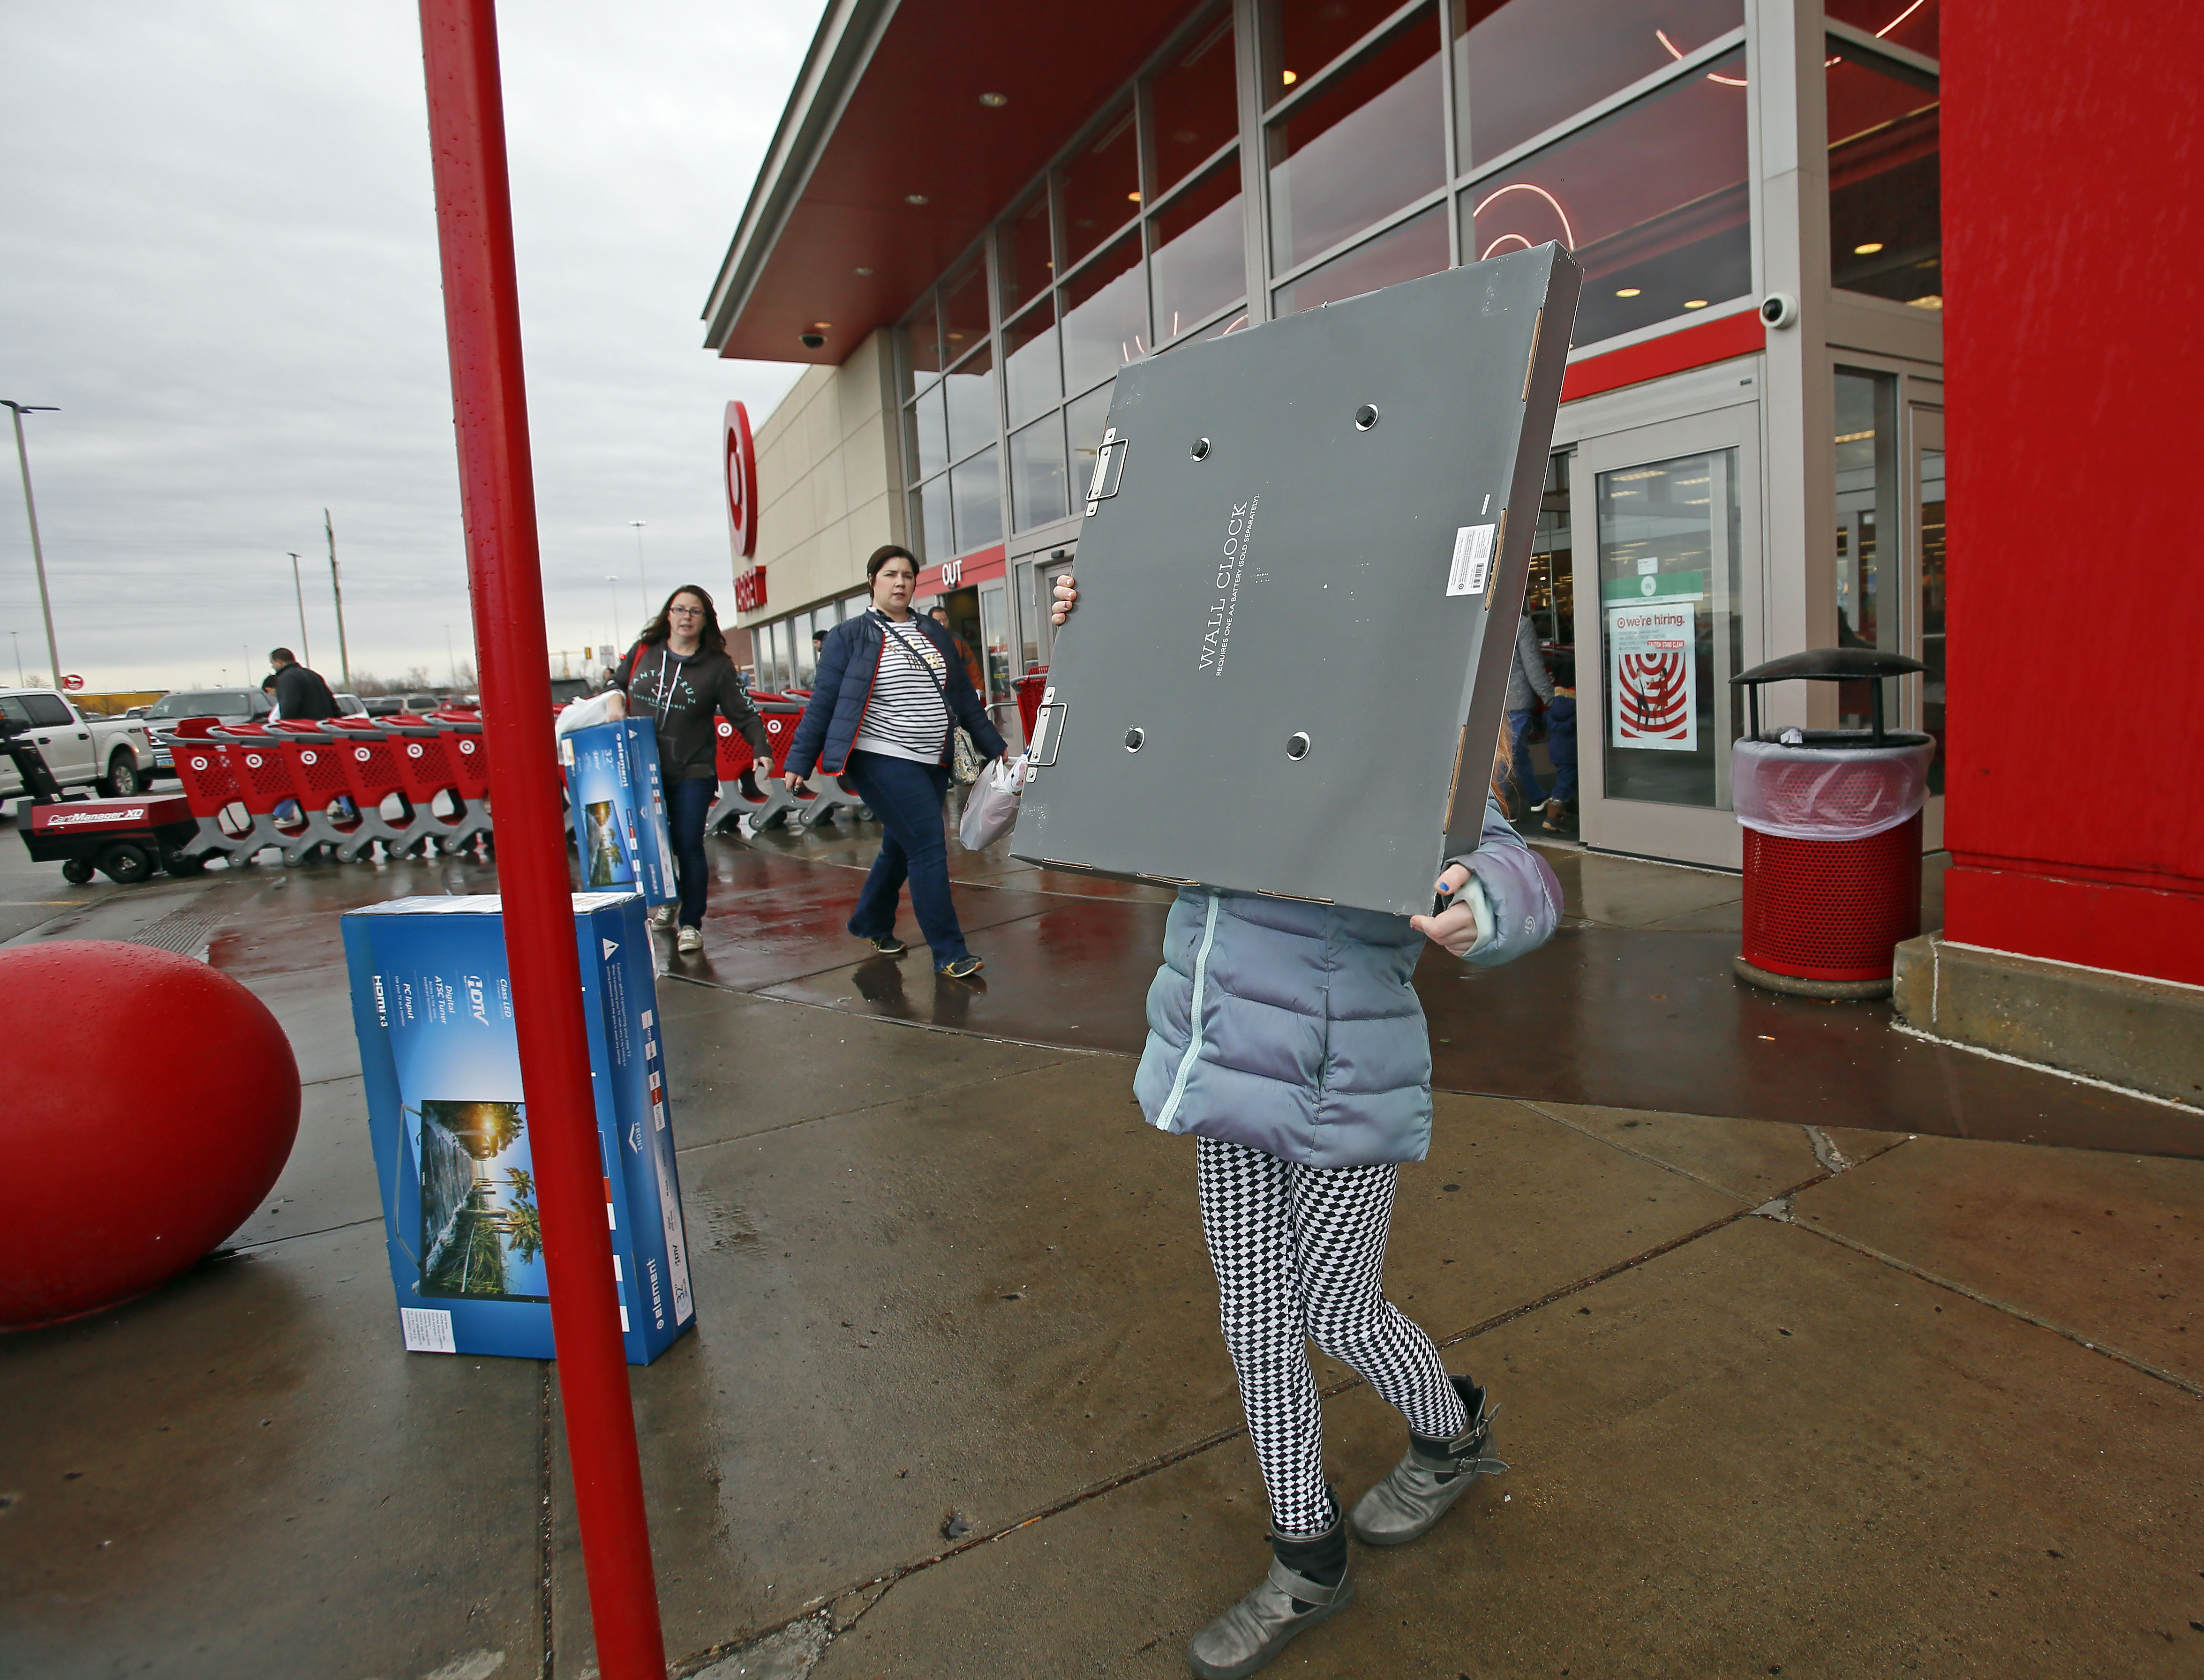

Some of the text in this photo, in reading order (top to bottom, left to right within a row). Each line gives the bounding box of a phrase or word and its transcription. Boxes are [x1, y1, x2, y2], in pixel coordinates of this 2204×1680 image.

[942, 559, 963, 586] OUT
[1198, 501, 1247, 671] WALL CLOCK
[1216, 494, 1260, 676] REQUIRES ONE AA BATTERY (SOLD SEPARATELY).
[1627, 613, 1685, 627] we're hiring.
[49, 809, 144, 823] CartManager XD
[374, 975, 386, 1013] HDMI
[403, 983, 414, 1019] PC Input
[435, 975, 447, 1025] ATSC Tuner
[445, 985, 456, 1013] Digital
[503, 1002, 512, 1018] LED
[379, 1015, 388, 1027] x3
[647, 1258, 662, 1319] element
